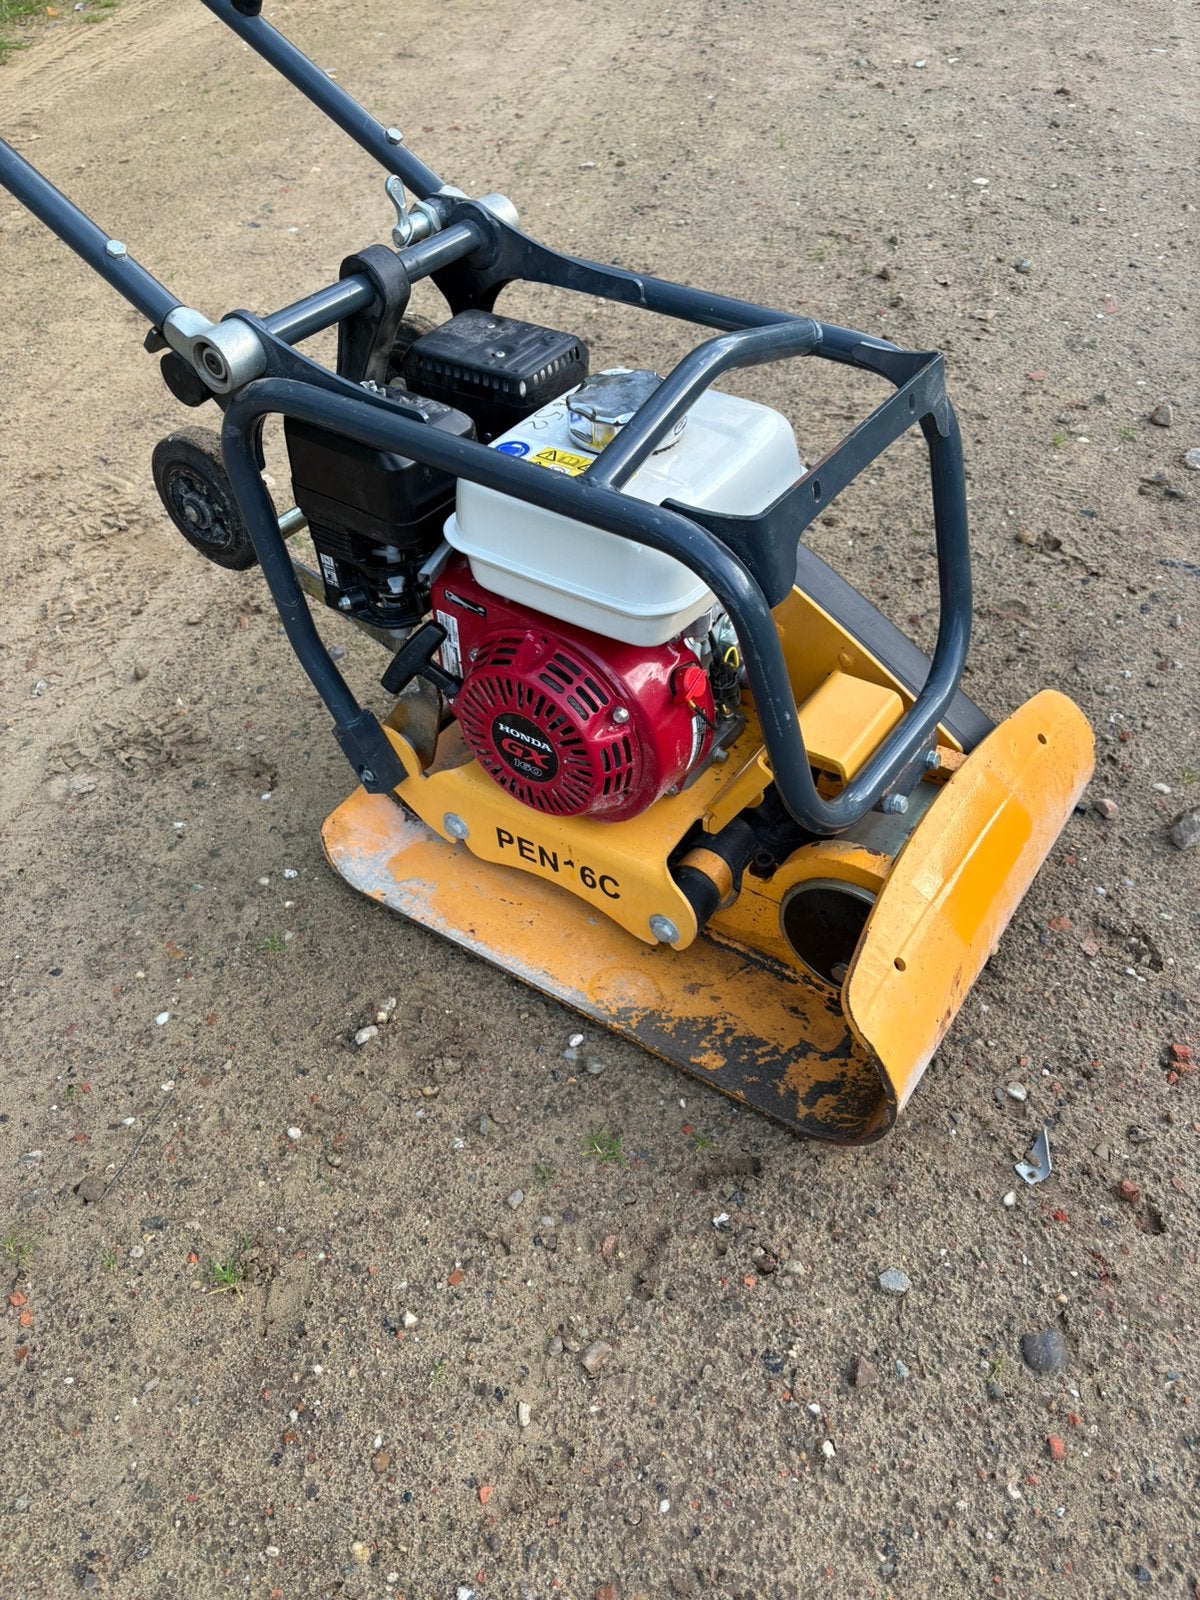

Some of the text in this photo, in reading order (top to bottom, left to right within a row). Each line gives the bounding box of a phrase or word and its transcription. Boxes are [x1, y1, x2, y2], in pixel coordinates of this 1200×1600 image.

[498, 723, 552, 753] HONDA
[501, 738, 551, 770] GX
[513, 757, 543, 777] 160
